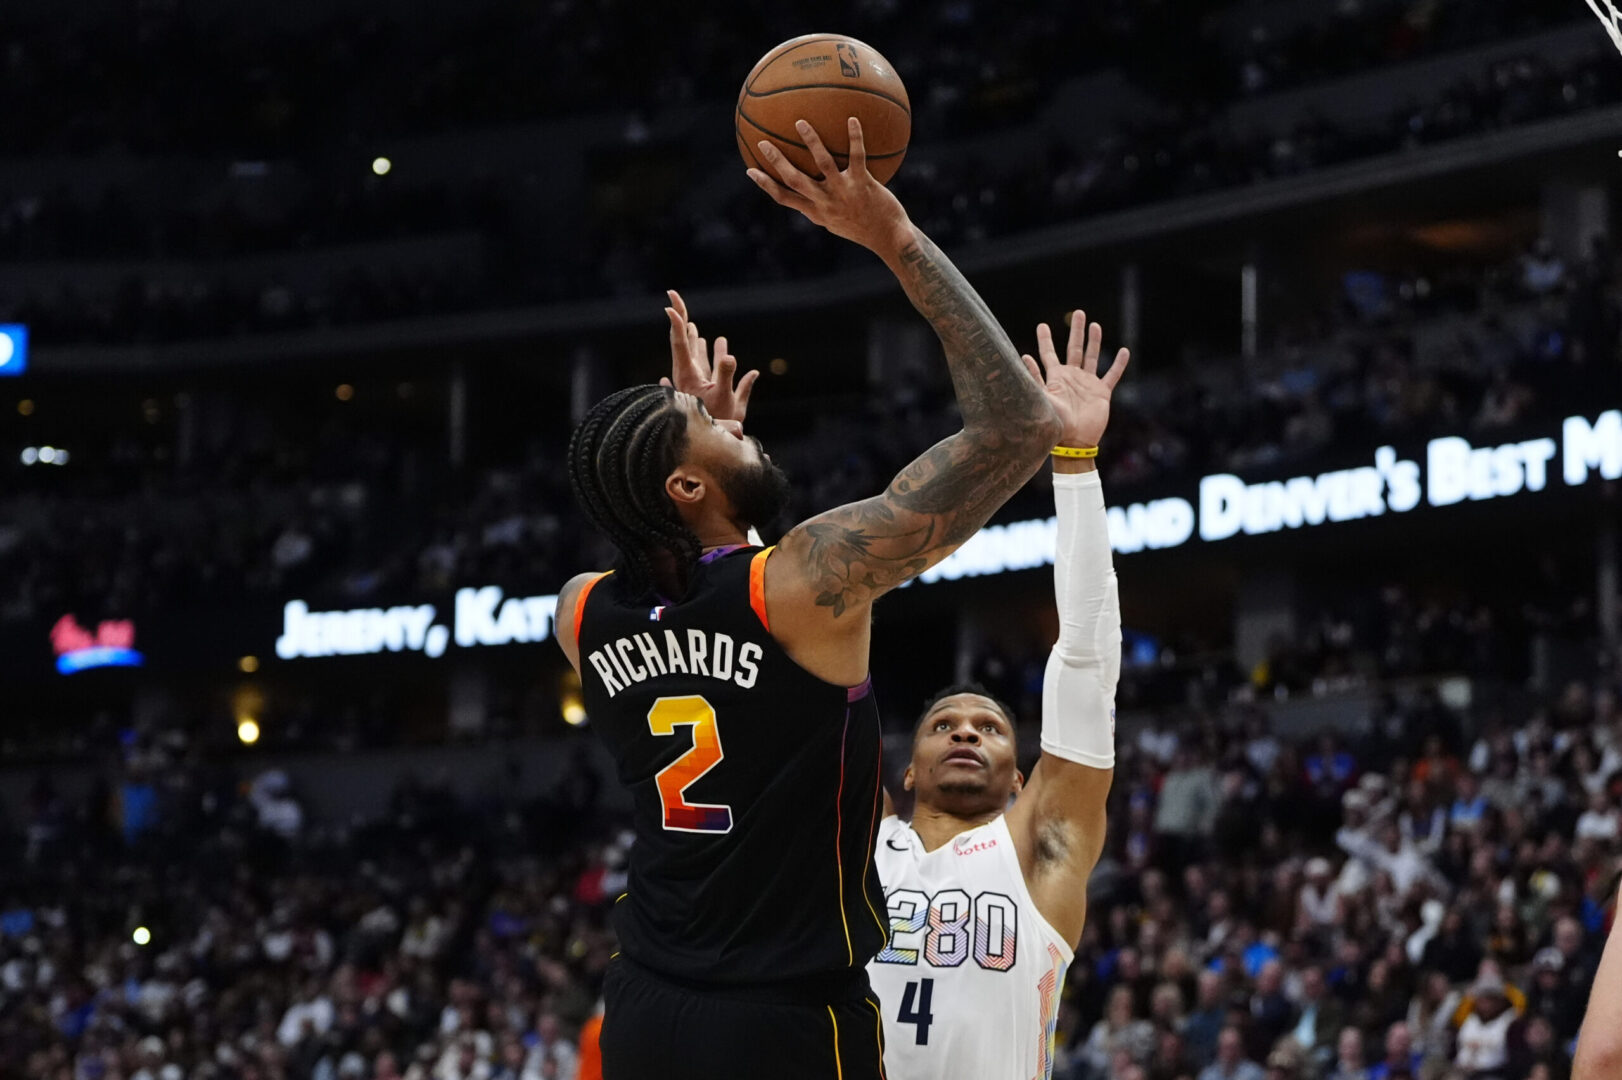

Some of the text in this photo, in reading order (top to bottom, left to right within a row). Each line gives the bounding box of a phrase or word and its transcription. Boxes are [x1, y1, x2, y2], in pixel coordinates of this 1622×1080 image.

[455, 585, 559, 647] KAT
[588, 628, 763, 698] RICHARDS
[647, 694, 733, 834] 2
[874, 886, 1017, 972] 280
[897, 978, 934, 1046] 4
